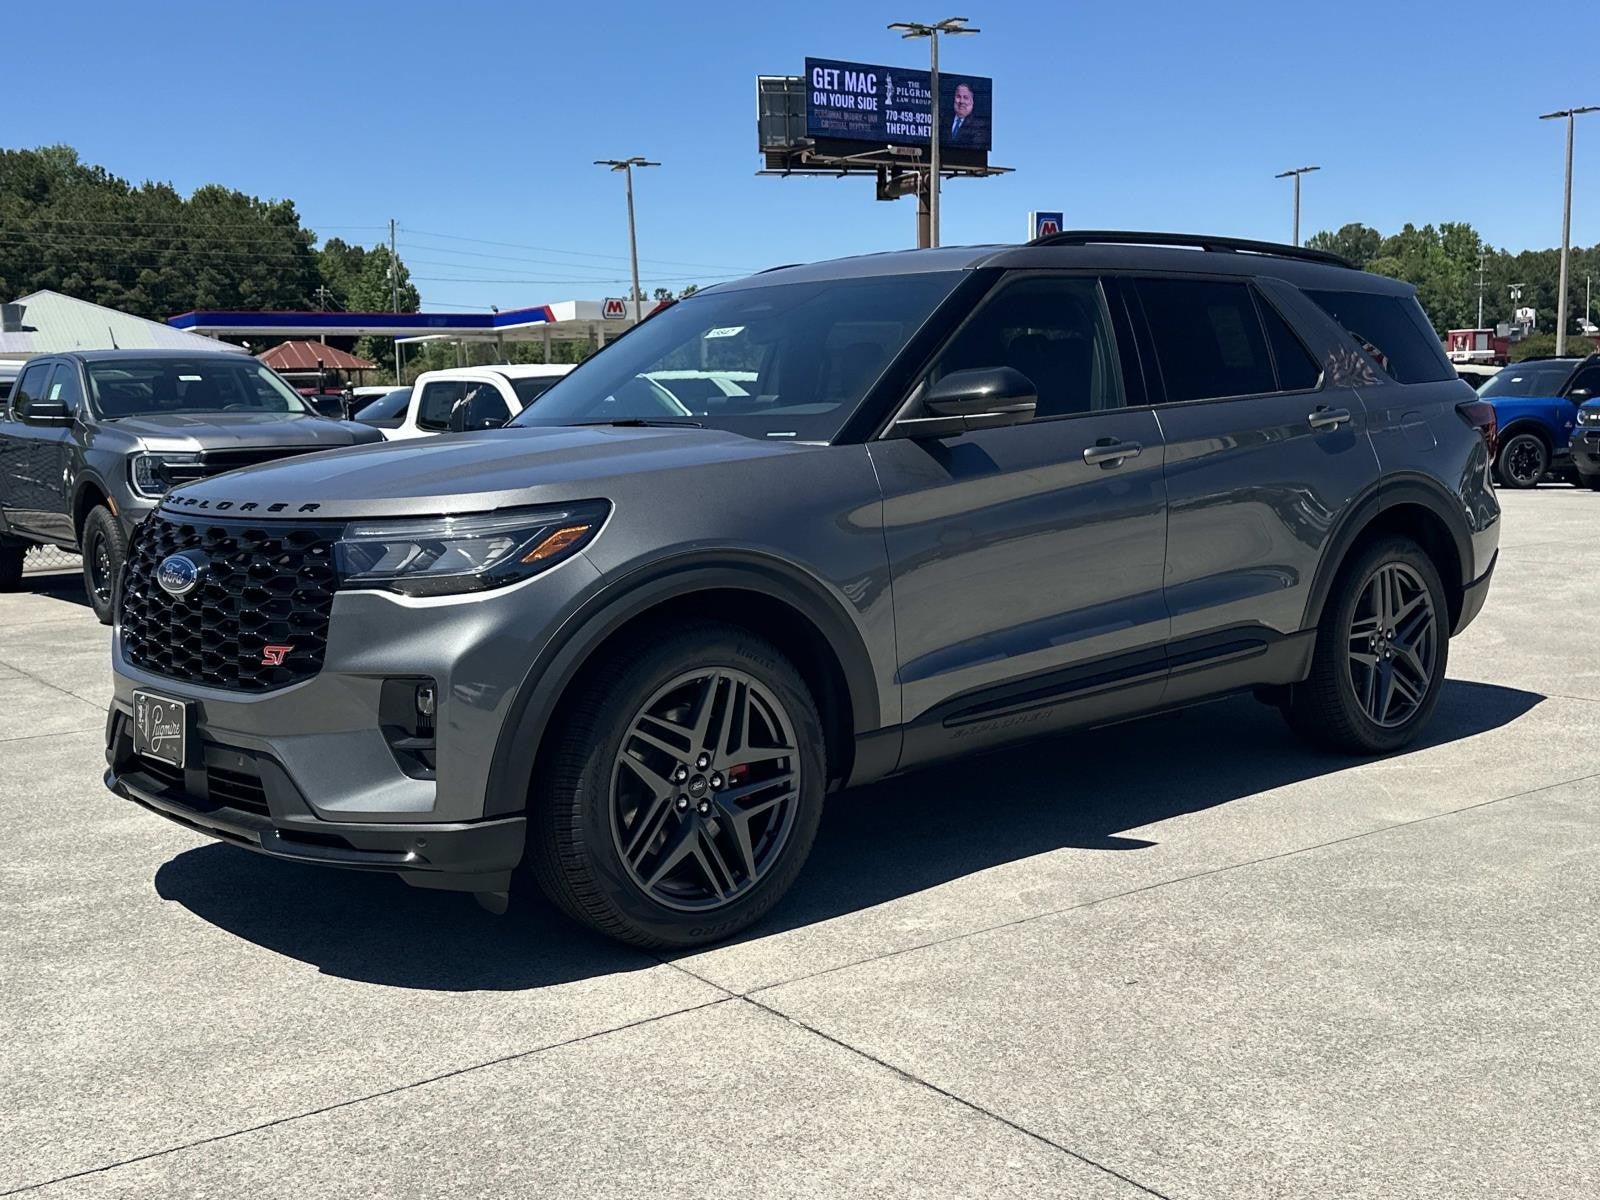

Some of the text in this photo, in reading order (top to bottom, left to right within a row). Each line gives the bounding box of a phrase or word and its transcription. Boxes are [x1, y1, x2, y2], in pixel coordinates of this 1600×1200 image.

[813, 67, 877, 94] GET MAC
[813, 91, 878, 111] ON YOUR SIDE
[896, 87, 931, 98] PILGRIM
[885, 110, 932, 124] 770-459-9210
[885, 122, 931, 138] THEPLG.NET
[607, 301, 623, 313] M
[165, 495, 321, 512] EXPLORER
[163, 562, 186, 584] Ford
[261, 645, 294, 665] ST
